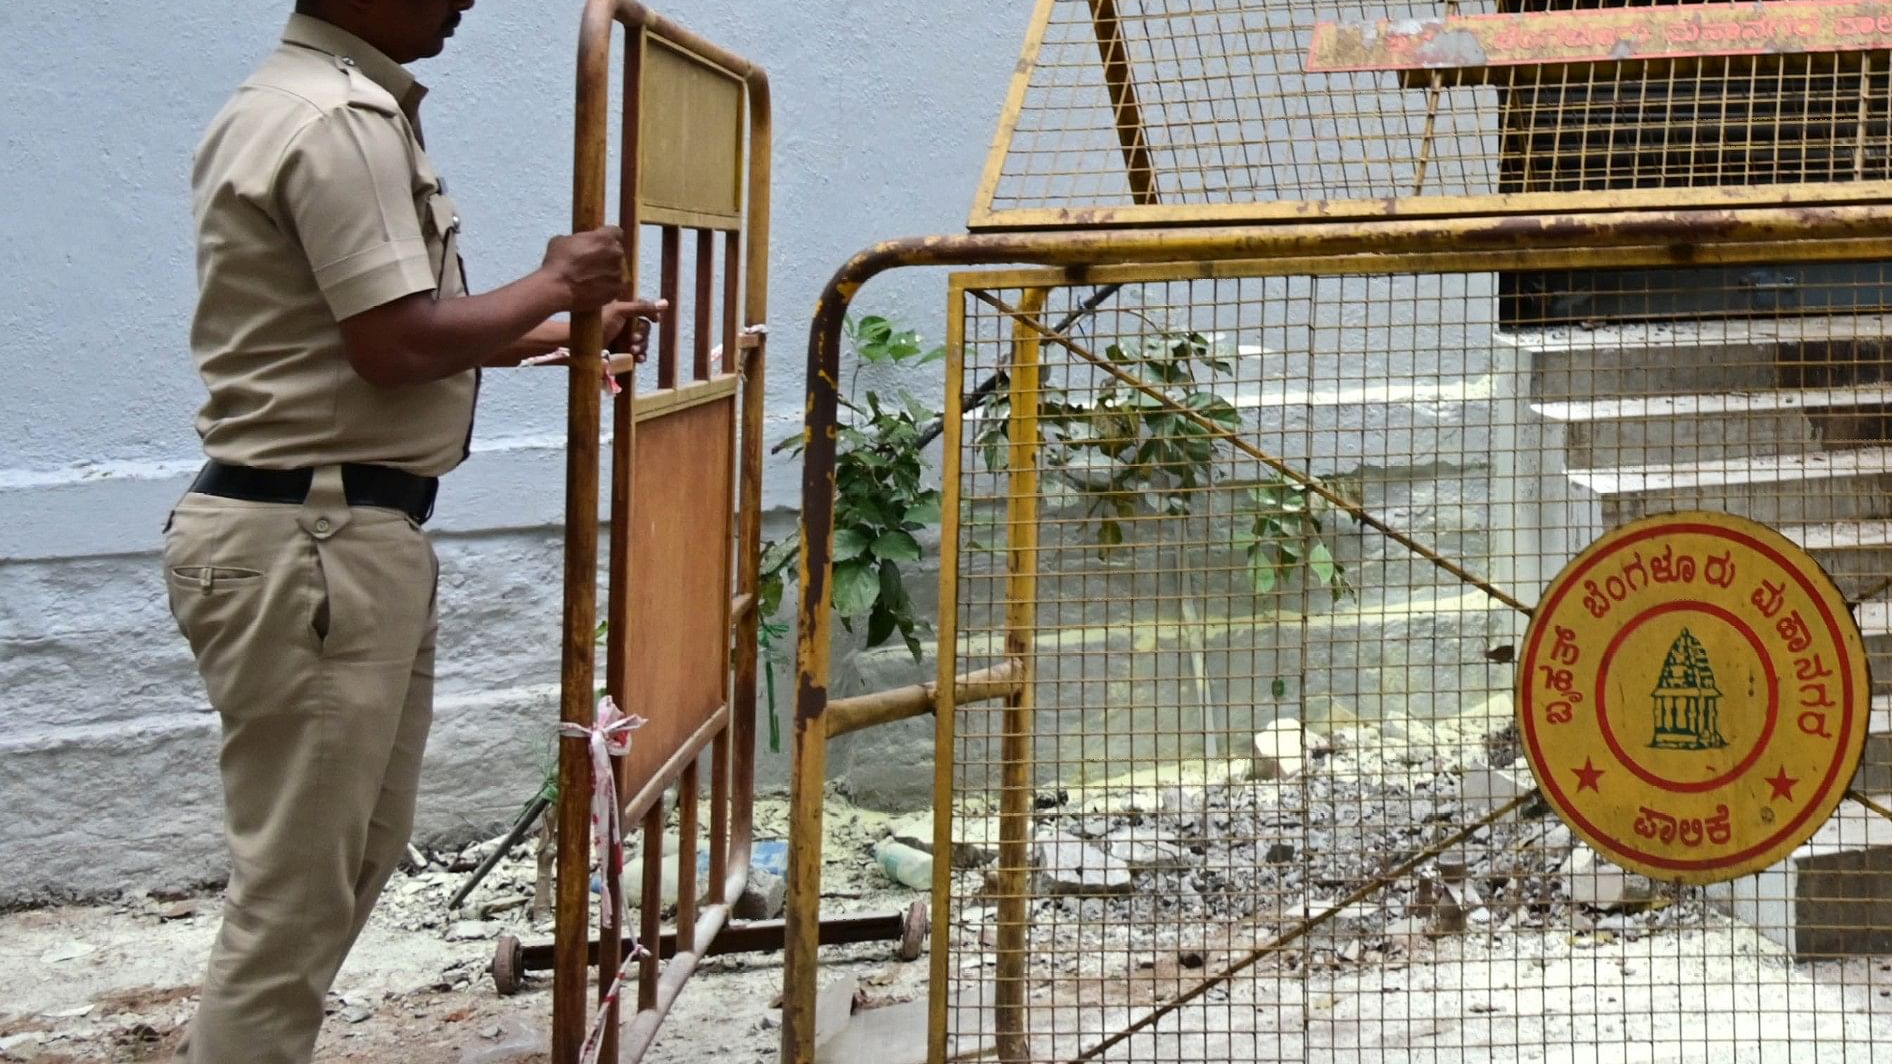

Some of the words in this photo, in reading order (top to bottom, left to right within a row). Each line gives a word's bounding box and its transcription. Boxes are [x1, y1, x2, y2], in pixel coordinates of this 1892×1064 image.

[1539, 625, 1583, 725] ಬೃಹತ್
[1583, 544, 1736, 619] ಬೆಂಗಳೂರು
[1751, 578, 1836, 739] ಮಹಾನಗರ
[1633, 804, 1732, 848] ಪಾಲಿಕೆ
